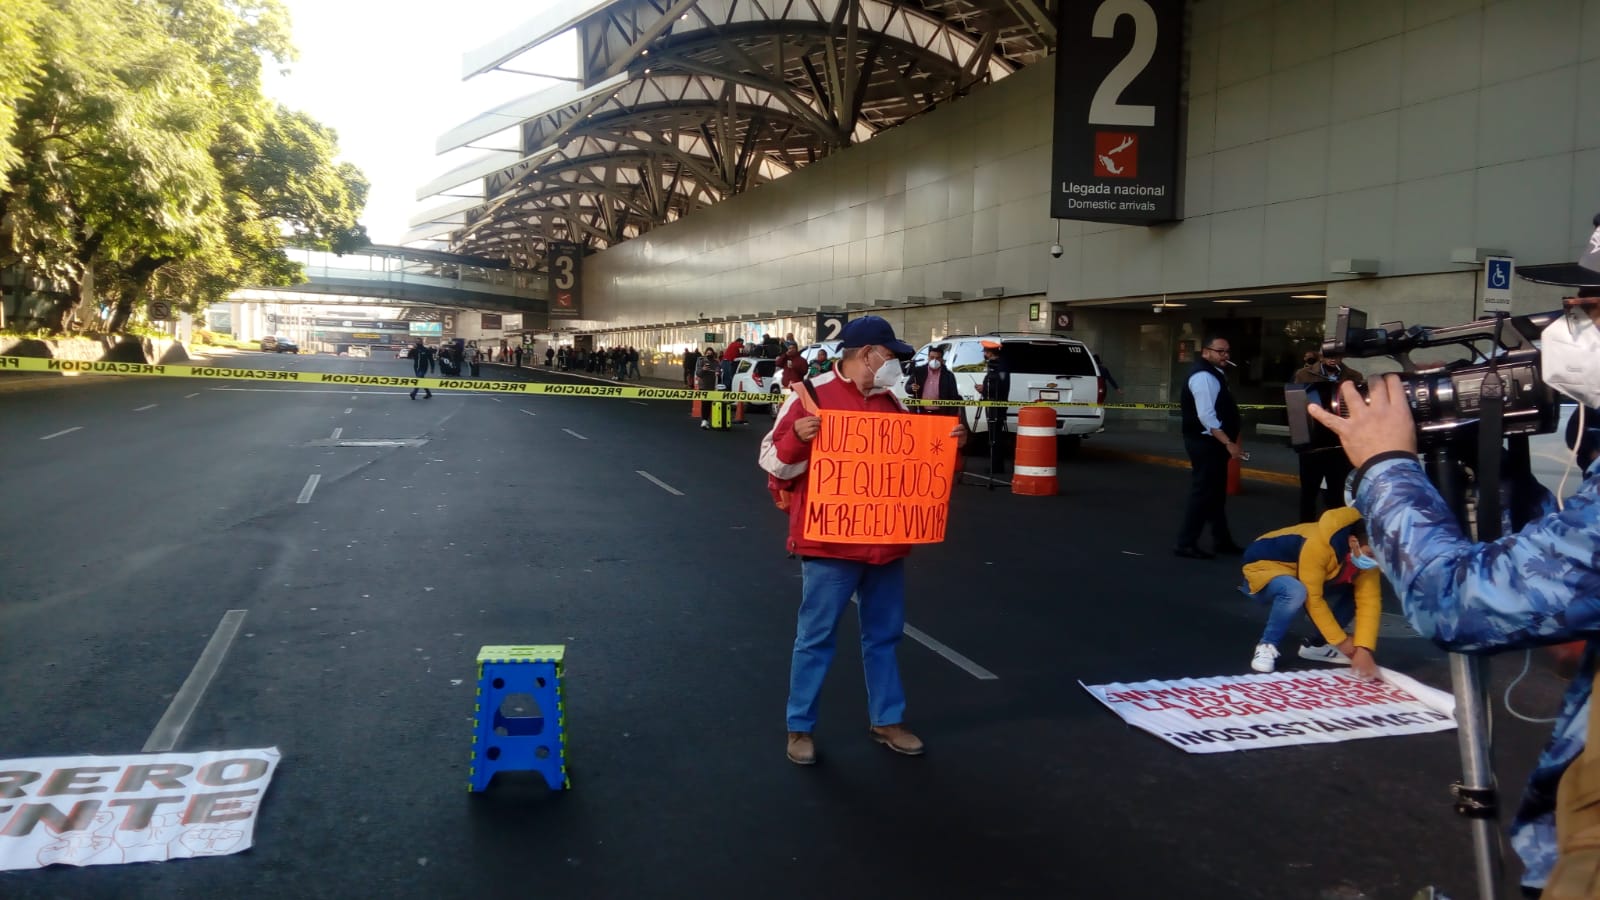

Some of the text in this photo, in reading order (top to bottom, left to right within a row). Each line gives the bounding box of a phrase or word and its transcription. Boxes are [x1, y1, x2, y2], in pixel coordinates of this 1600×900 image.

[1088, 0, 1158, 126] 2
[1062, 182, 1165, 196] Llegada nacional
[1068, 199, 1156, 211] Domestic arrivals
[555, 255, 575, 290] 3
[824, 318, 842, 340] 2
[813, 457, 947, 500] PEQUEÑOS
[1131, 697, 1186, 712] LA
[1176, 694, 1245, 708] VOZ
[1184, 702, 1274, 720] AGUA
[0, 788, 260, 838] NTE
